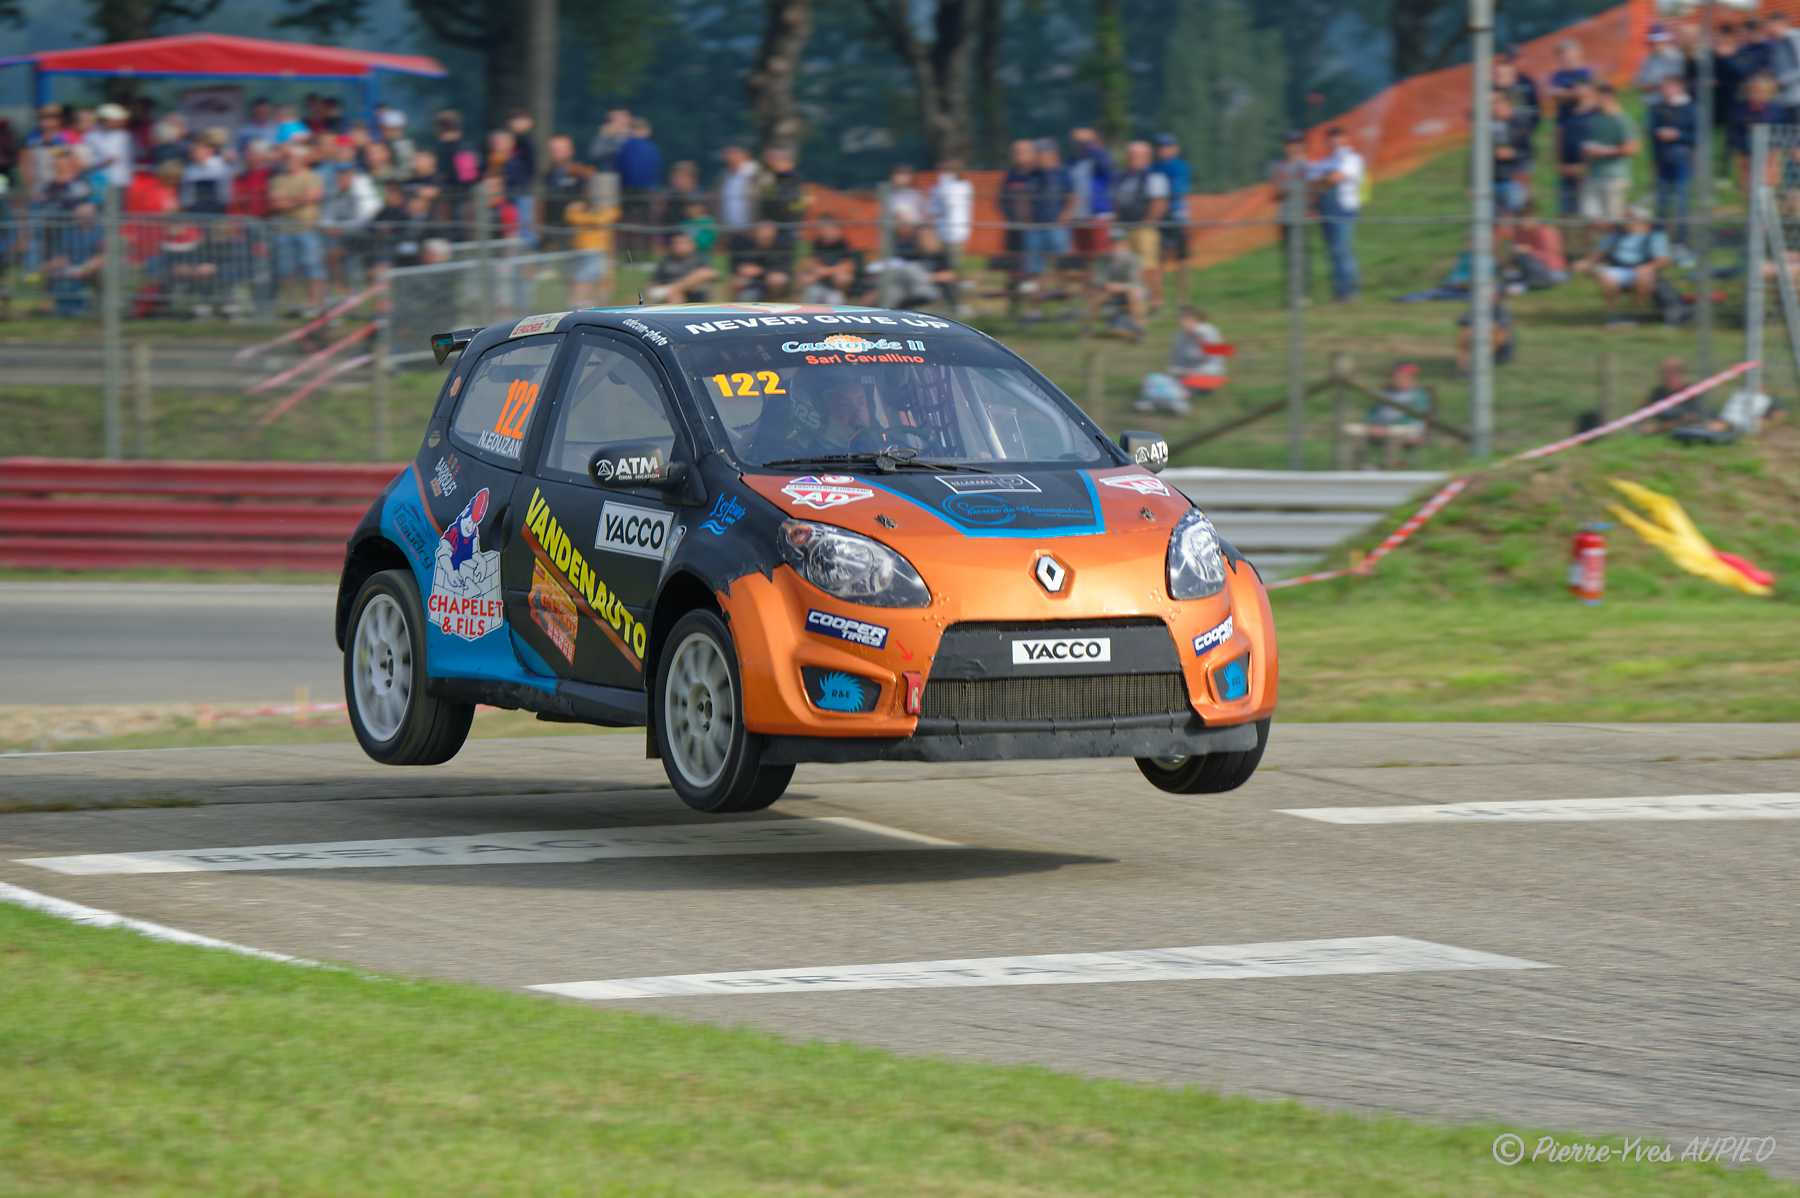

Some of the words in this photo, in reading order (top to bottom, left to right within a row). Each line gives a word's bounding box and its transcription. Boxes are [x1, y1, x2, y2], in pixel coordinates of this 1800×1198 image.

[685, 316, 808, 335] NEVER
[814, 315, 897, 325] GIVE
[901, 319, 950, 329] UP
[805, 353, 840, 365] Sarl
[844, 353, 925, 365] Cavallino
[713, 371, 786, 397] 122
[494, 379, 539, 440] 122
[615, 456, 658, 475] ATM
[604, 513, 665, 549] YACCO
[525, 487, 647, 660] VANDENAUTO
[428, 594, 503, 618] CHAPELET
[442, 617, 452, 633] &
[456, 618, 485, 636] FILS
[808, 611, 886, 640] COOPER
[841, 630, 881, 647] TIRES
[1023, 641, 1101, 660] YACCO
